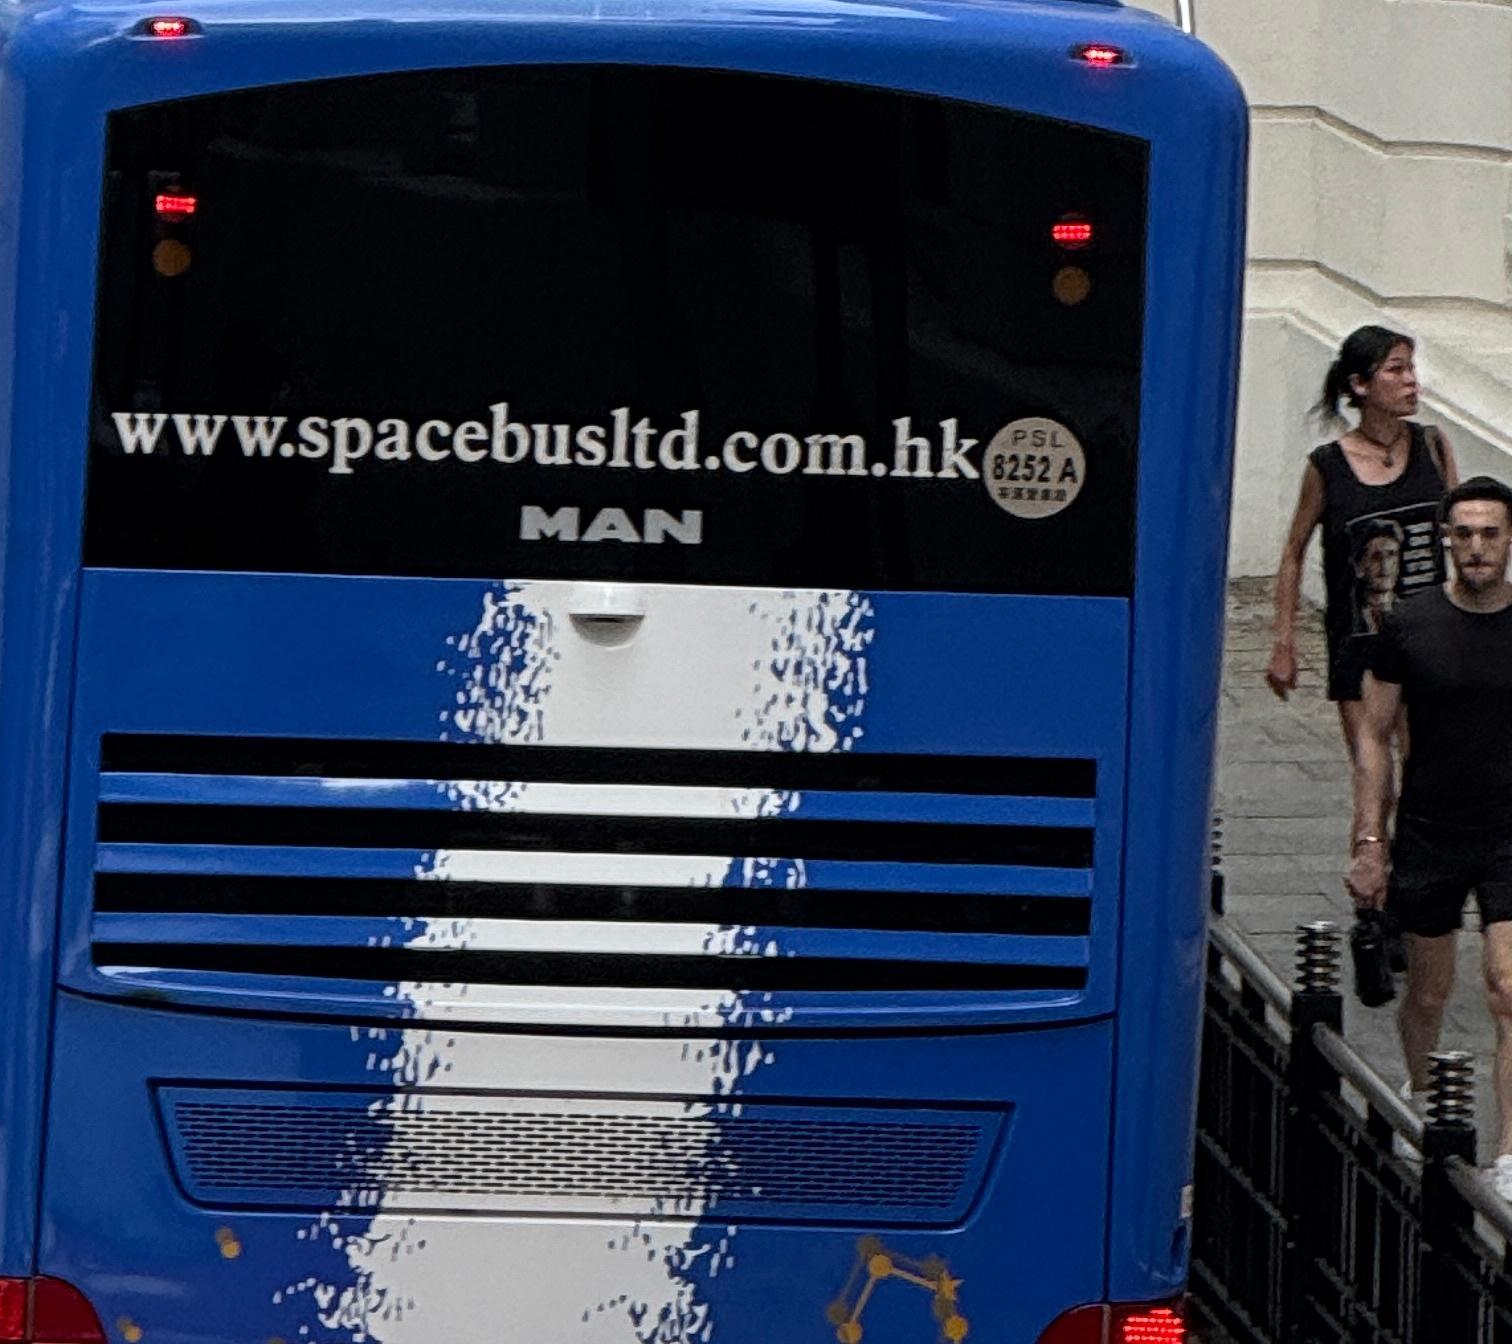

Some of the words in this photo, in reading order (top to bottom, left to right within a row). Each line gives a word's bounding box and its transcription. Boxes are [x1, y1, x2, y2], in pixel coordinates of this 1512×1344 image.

[111, 402, 980, 480] www.spacebusltd.com.hk
[1012, 429, 1066, 448] PSL
[992, 453, 1051, 484] 8252
[1056, 457, 1079, 484] A
[519, 505, 703, 545] MAN
